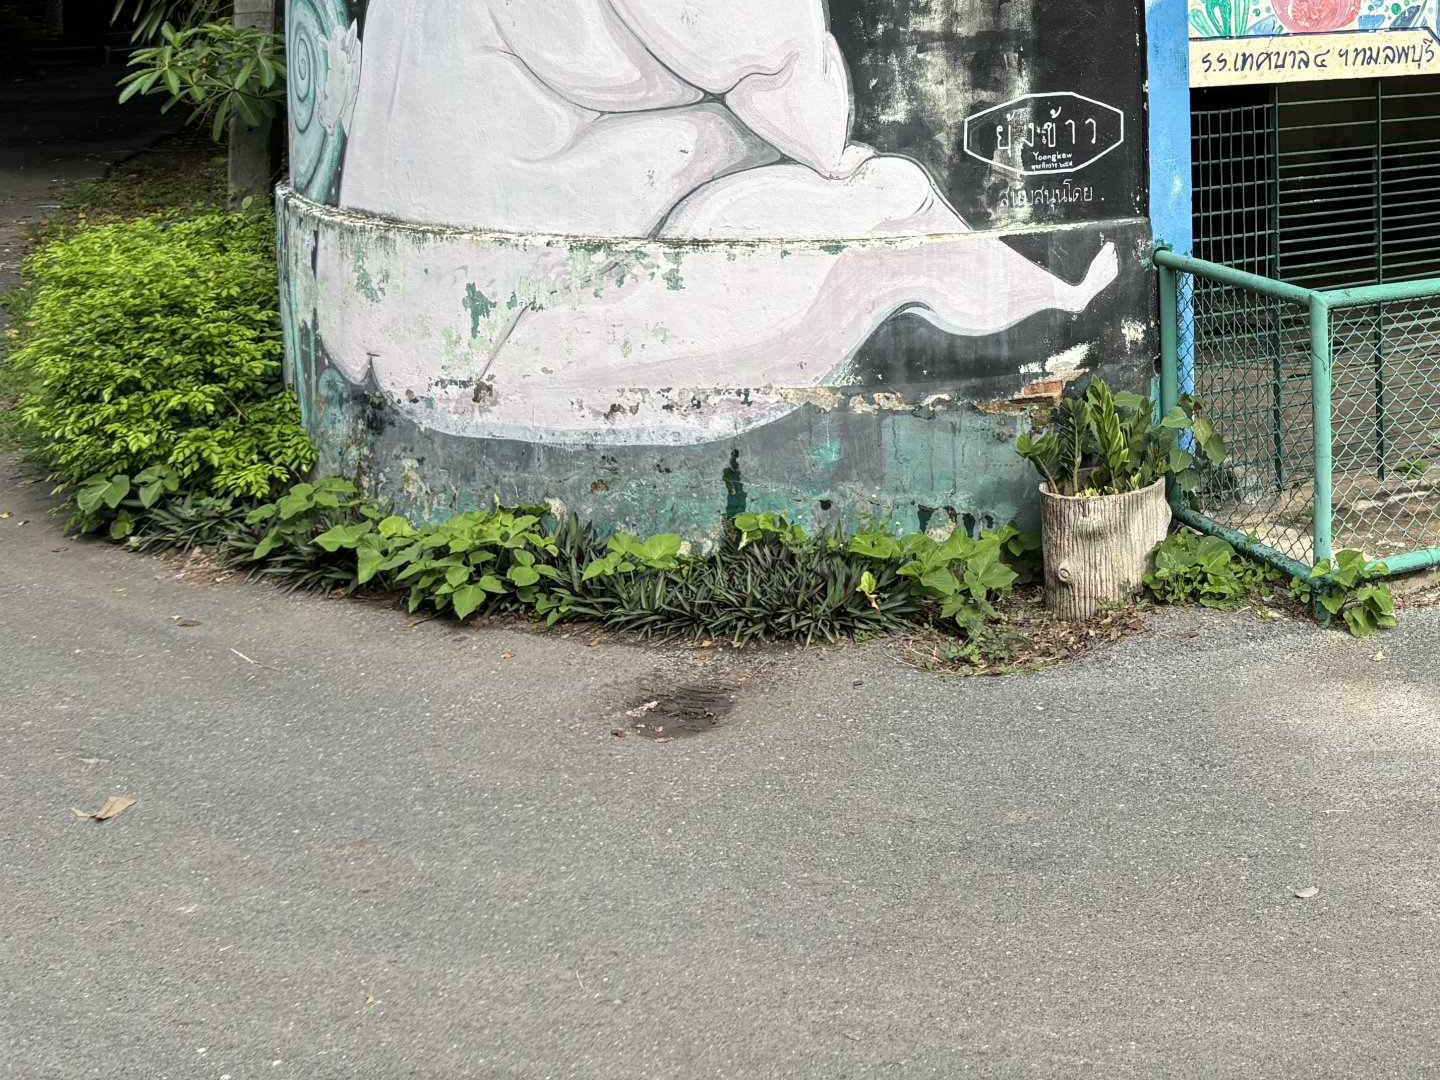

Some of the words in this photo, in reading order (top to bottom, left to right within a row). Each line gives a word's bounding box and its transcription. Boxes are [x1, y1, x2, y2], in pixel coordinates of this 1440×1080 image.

[1032, 150, 1073, 163] Yoongkaw
[999, 179, 1093, 211] สนบสนุนโดย
